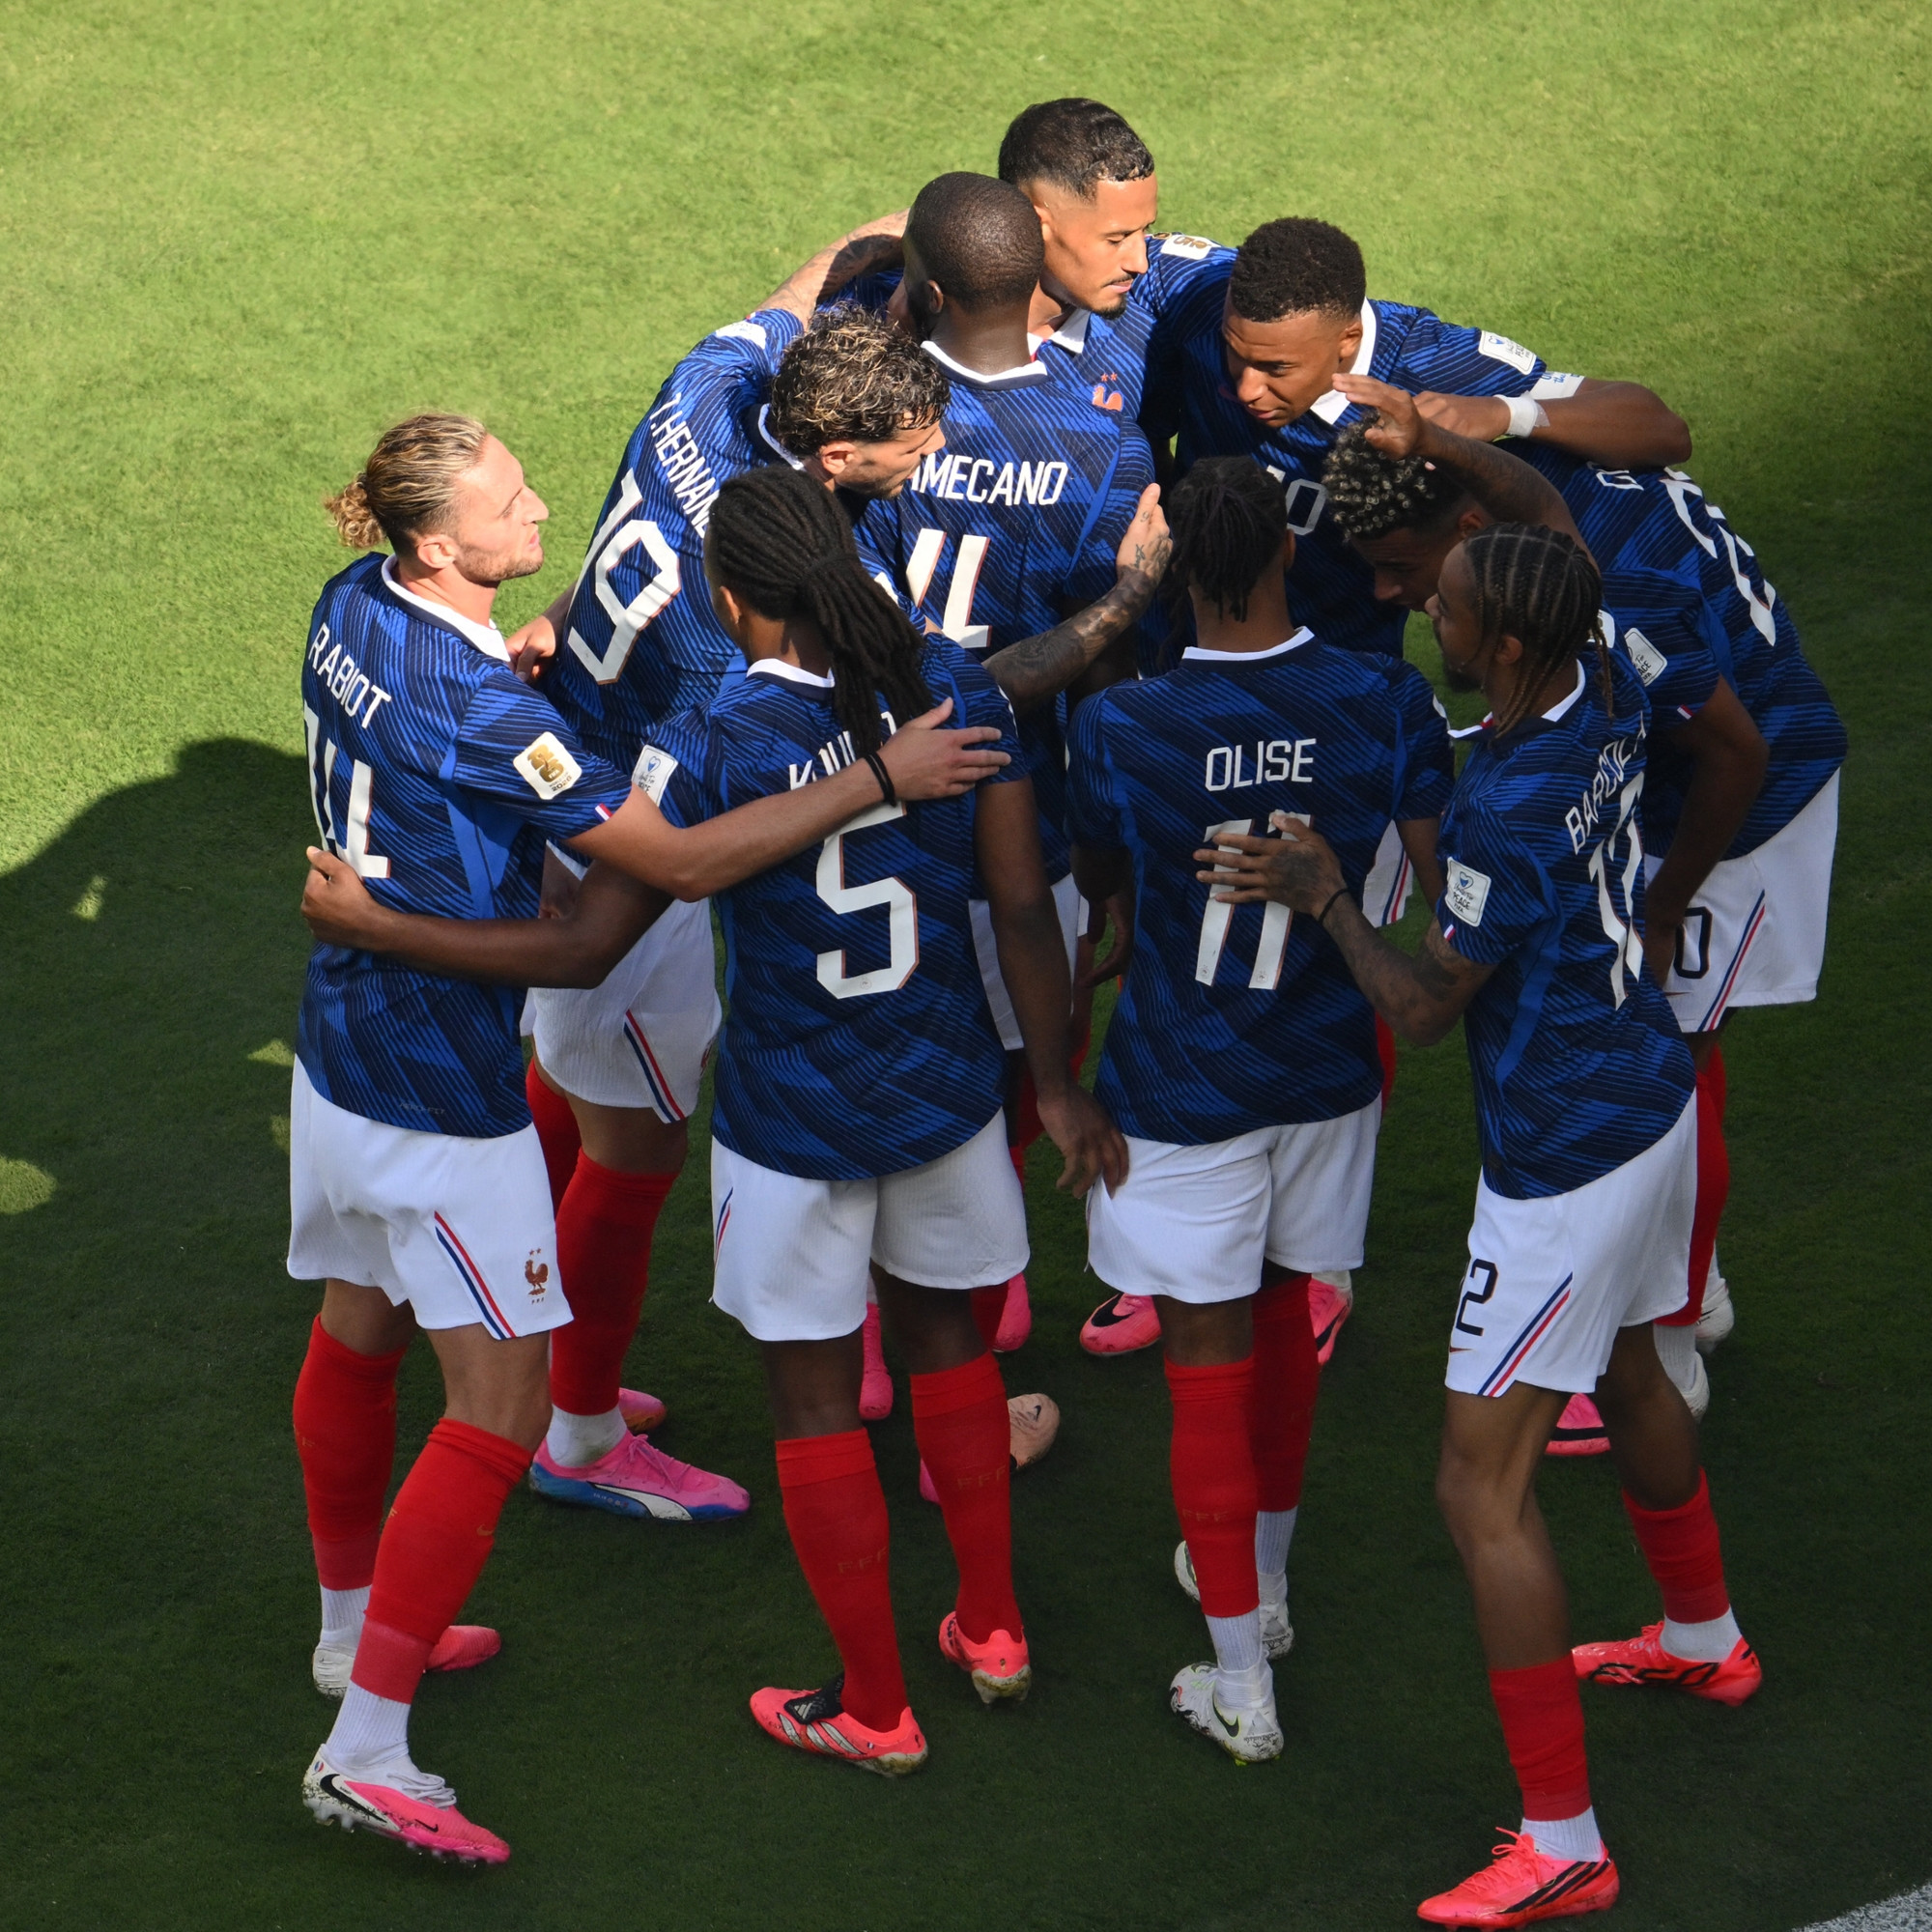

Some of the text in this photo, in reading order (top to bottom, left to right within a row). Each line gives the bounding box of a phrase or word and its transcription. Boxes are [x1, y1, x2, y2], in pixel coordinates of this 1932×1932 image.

[564, 468, 681, 685] 19
[308, 622, 391, 729] RABIOT
[1205, 738, 1318, 792] OLISE
[303, 698, 391, 879] 14
[816, 801, 920, 1000] 5
[1195, 810, 1316, 991] 11
